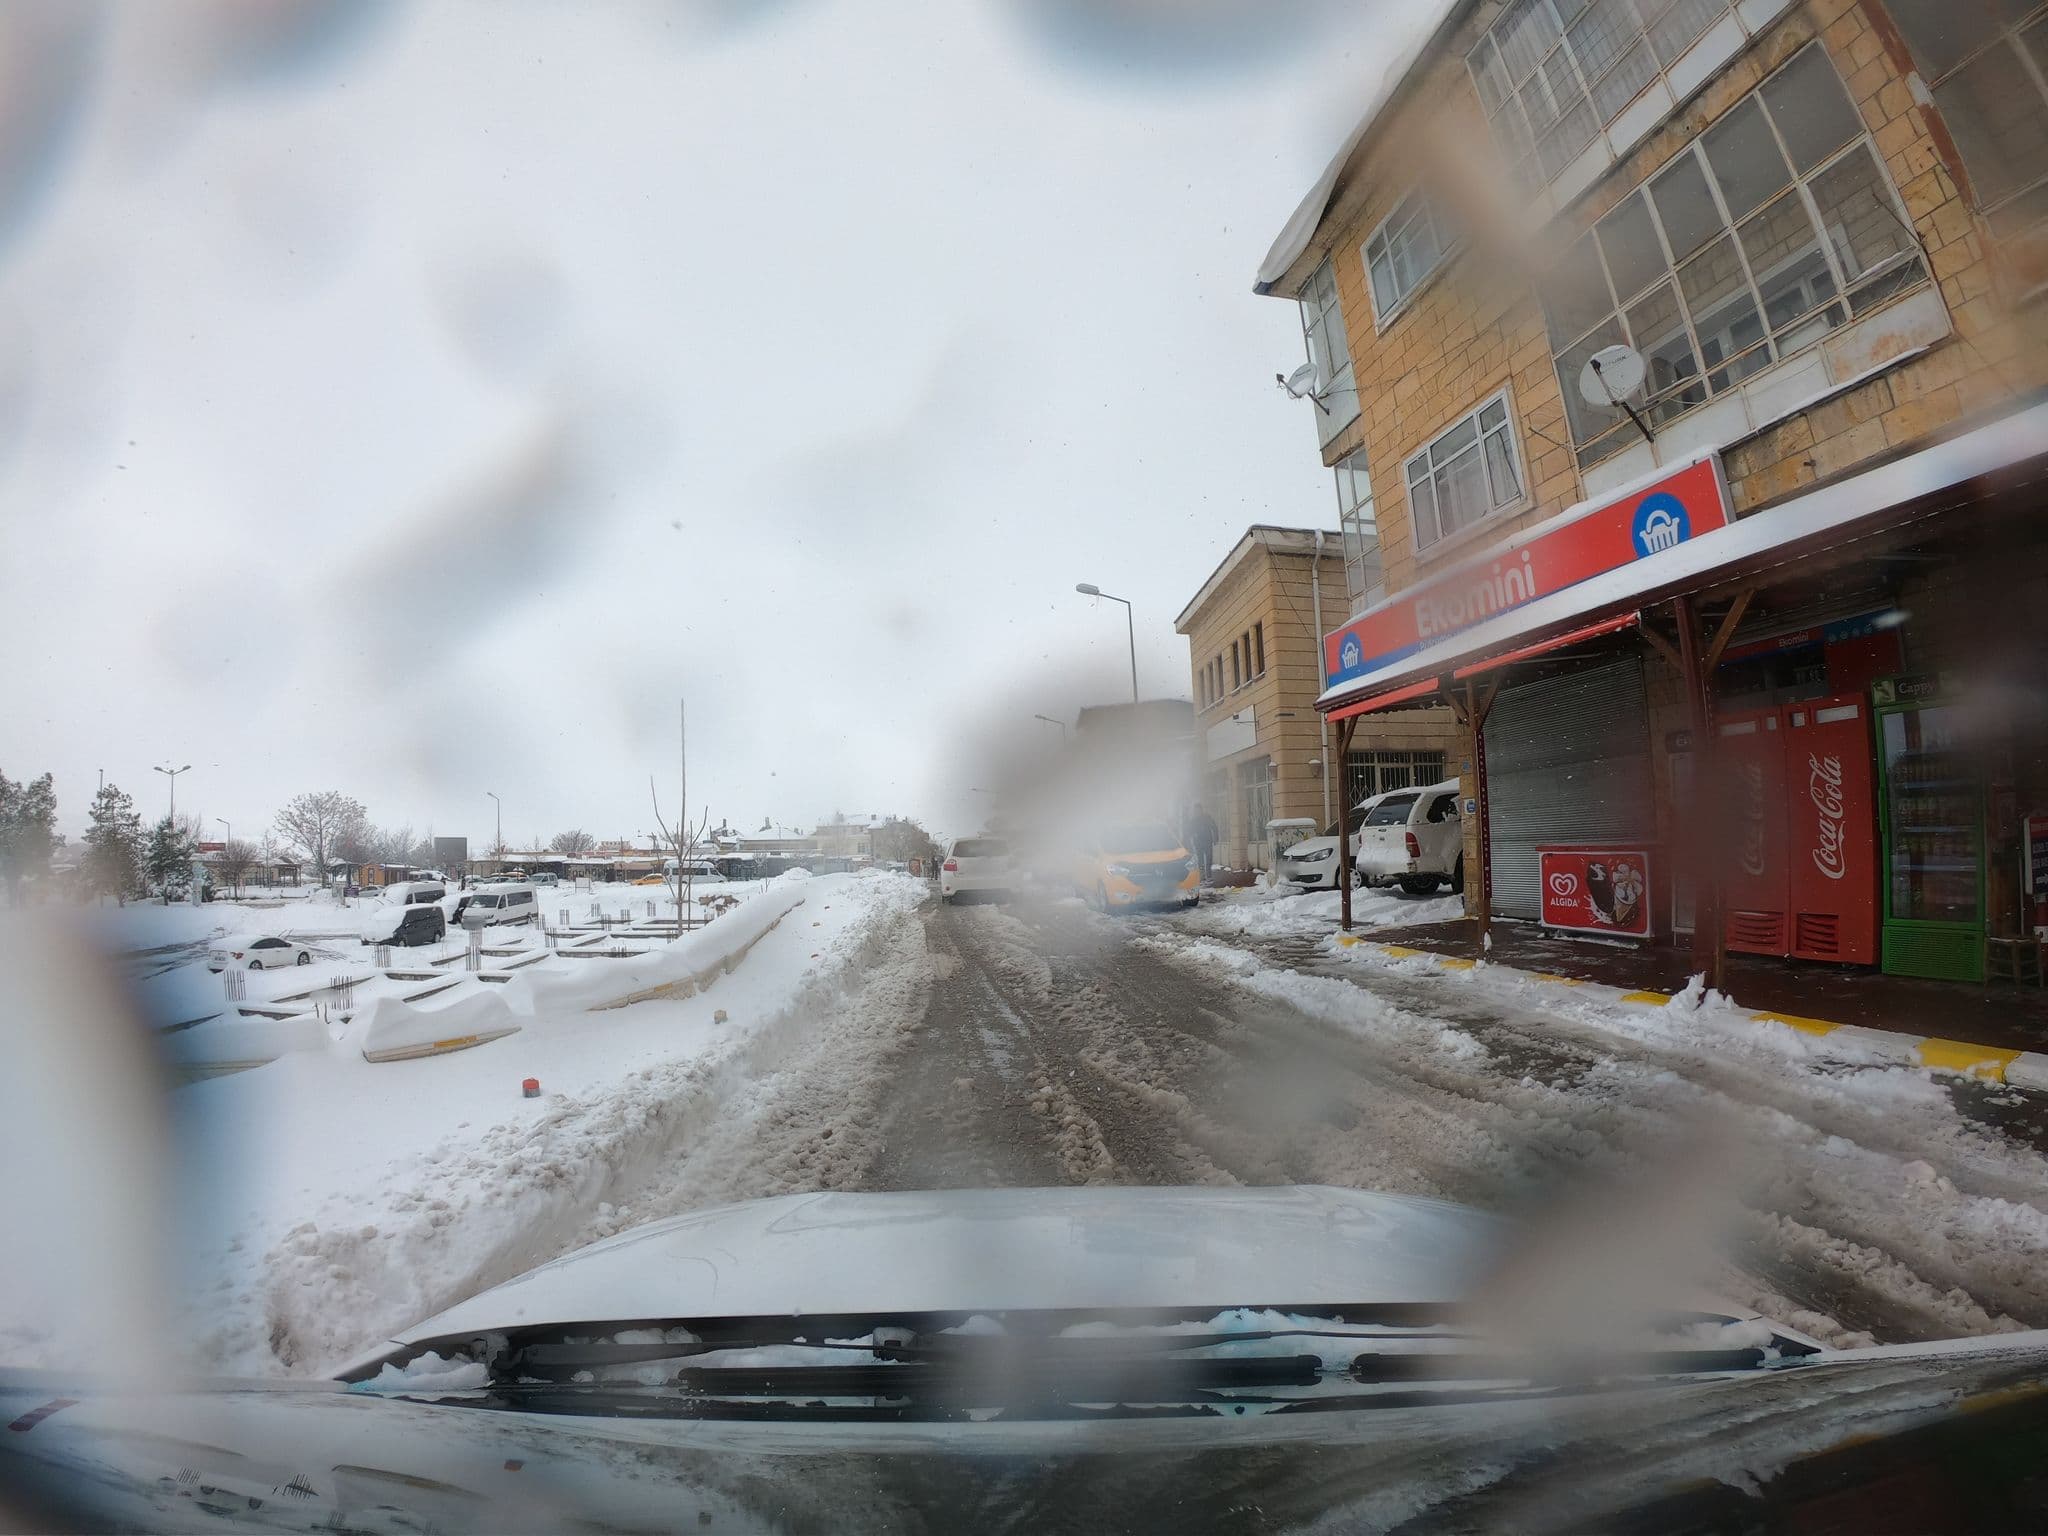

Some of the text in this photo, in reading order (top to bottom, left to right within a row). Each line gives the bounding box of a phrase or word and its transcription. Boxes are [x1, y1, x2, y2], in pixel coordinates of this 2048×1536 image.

[1415, 549, 1536, 638] Ekomini
[1778, 632, 1809, 648] Ekomini
[1550, 897, 1578, 908] ALGIDA
